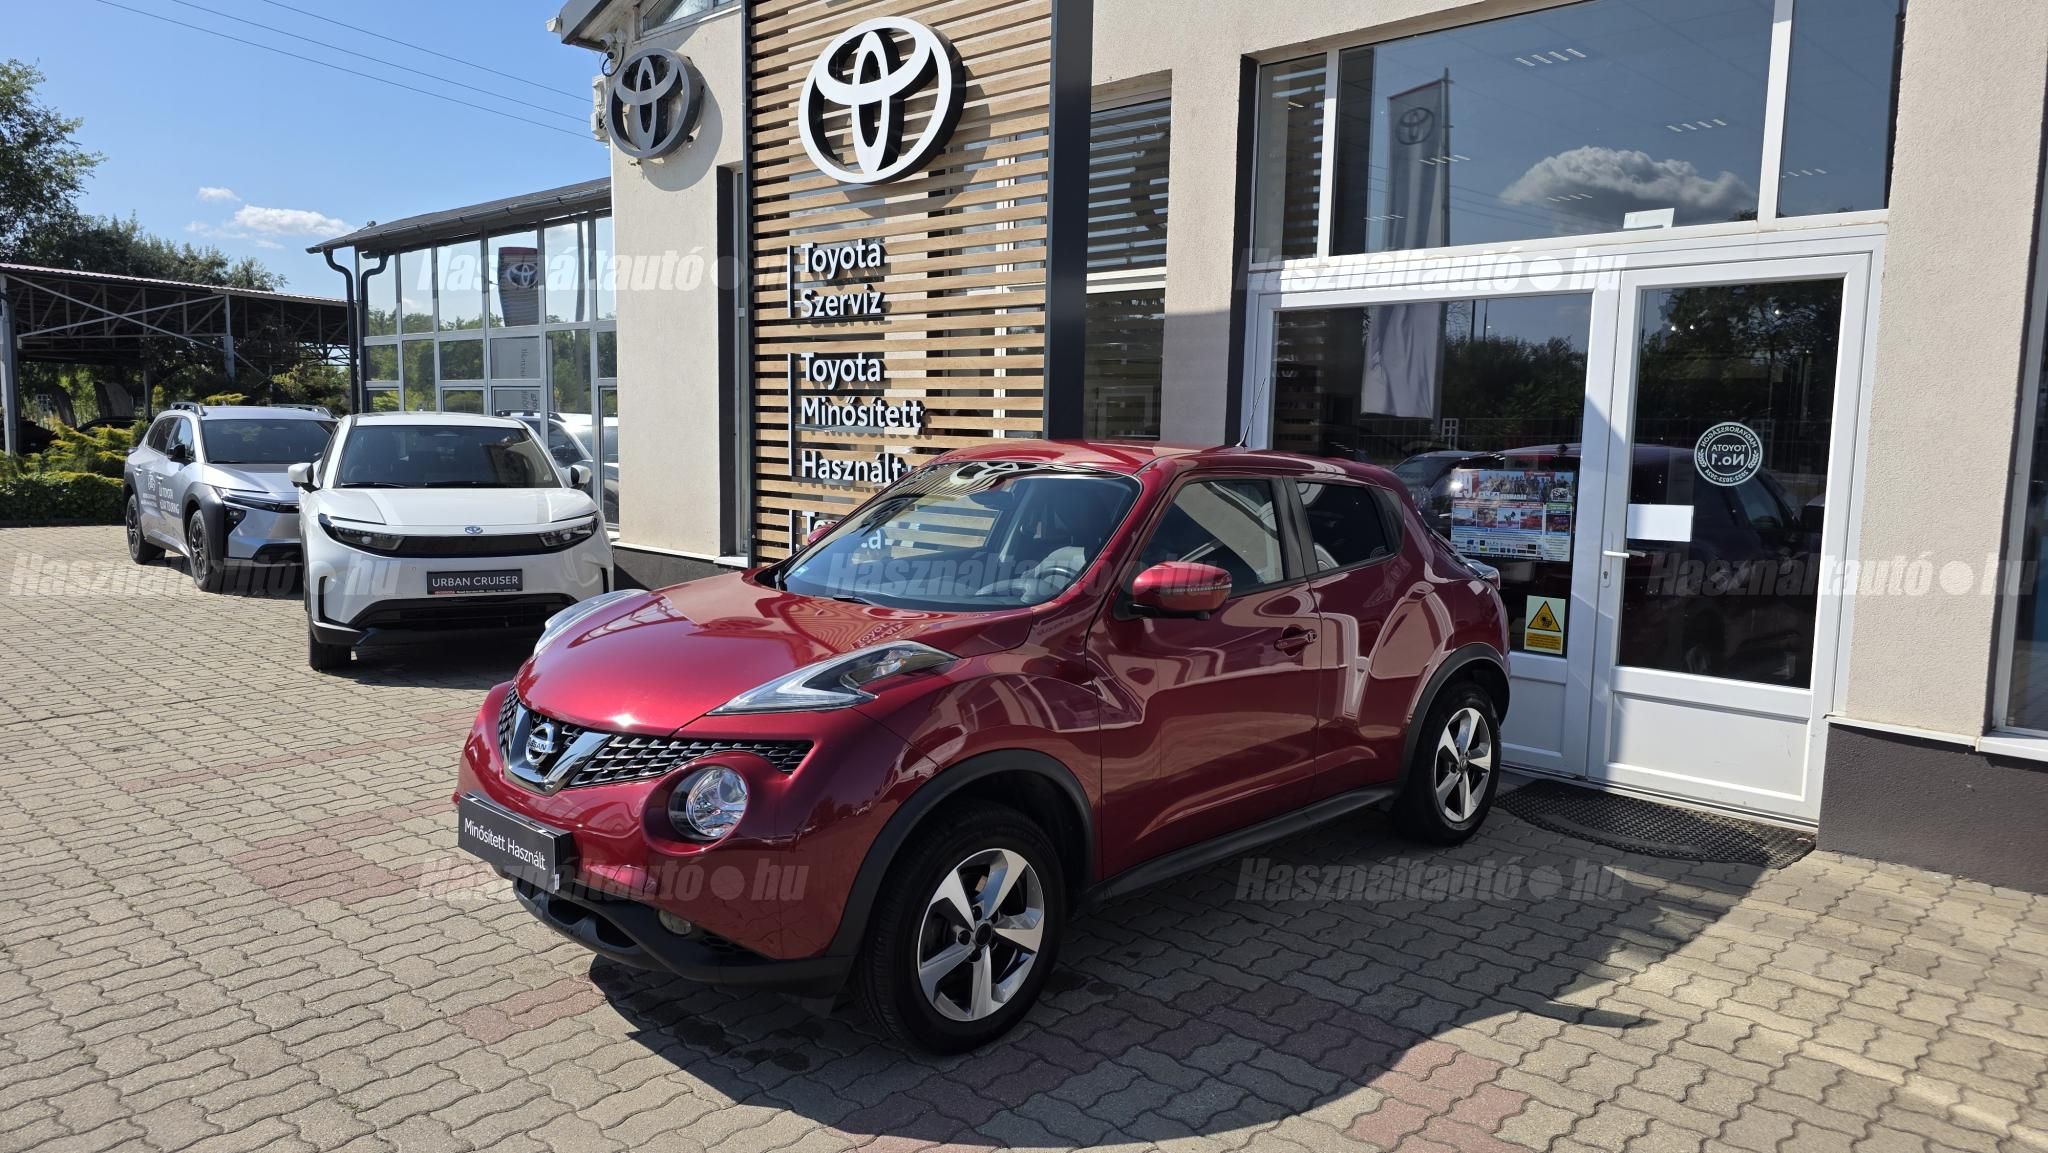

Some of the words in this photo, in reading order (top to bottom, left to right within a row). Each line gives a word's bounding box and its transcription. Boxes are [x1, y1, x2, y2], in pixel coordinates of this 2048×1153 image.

[801, 239, 881, 279] Toyota
[801, 284, 881, 317] Szerviz
[801, 352, 881, 390] Toyota
[801, 396, 922, 427] Minősített
[802, 450, 901, 485] Használt
[432, 577, 471, 587] URBAN
[473, 575, 519, 586] CRUISER
[465, 817, 506, 852] Minősített
[507, 837, 546, 871] Használt
